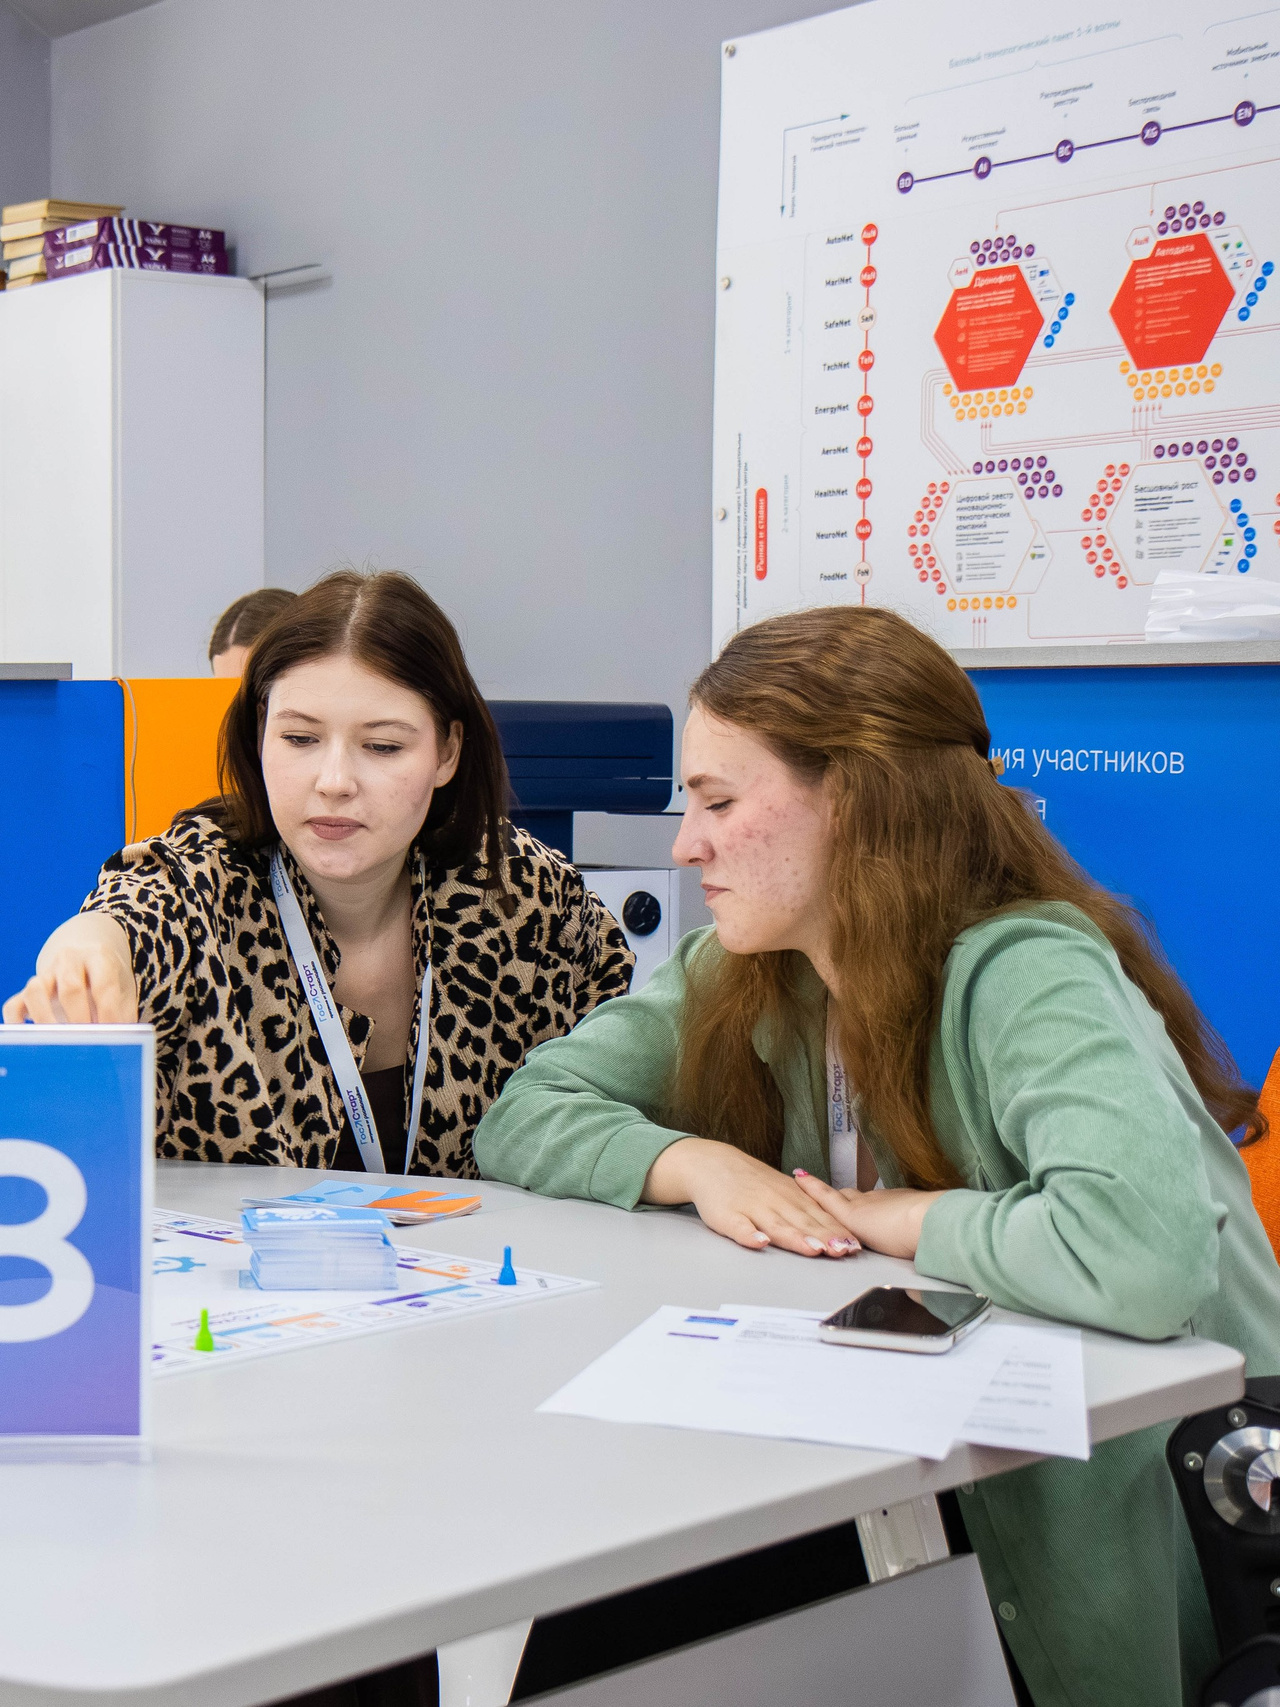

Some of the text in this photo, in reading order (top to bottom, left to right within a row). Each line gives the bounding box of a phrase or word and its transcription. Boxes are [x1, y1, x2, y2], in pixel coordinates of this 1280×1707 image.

[1238, 107, 1253, 119] EN
[977, 162, 988, 174] AI
[198, 230, 212, 240] A4
[826, 234, 853, 245] AutoNet
[201, 253, 216, 264] A4
[825, 276, 852, 286] MariNet
[973, 273, 1017, 288] Дронофлот
[824, 319, 851, 329] SafeNet
[822, 361, 850, 371] TechNet
[814, 404, 849, 415] EnergyNet
[821, 446, 848, 456] AeroNet
[857, 484, 871, 493] HeN
[1134, 481, 1198, 493] Бесшовный рост
[814, 489, 848, 498] HealthNet
[956, 492, 1014, 503] Цифровой реестр
[956, 504, 1006, 512] инновационно-
[757, 498, 765, 530] ставки
[956, 512, 1011, 521] технологических
[857, 525, 871, 534] NeN
[956, 521, 987, 531] компаний
[816, 530, 847, 540] NeuroNet
[756, 541, 765, 572] Рынки
[820, 572, 847, 581] FoodNet
[1032, 748, 1185, 777] участников
